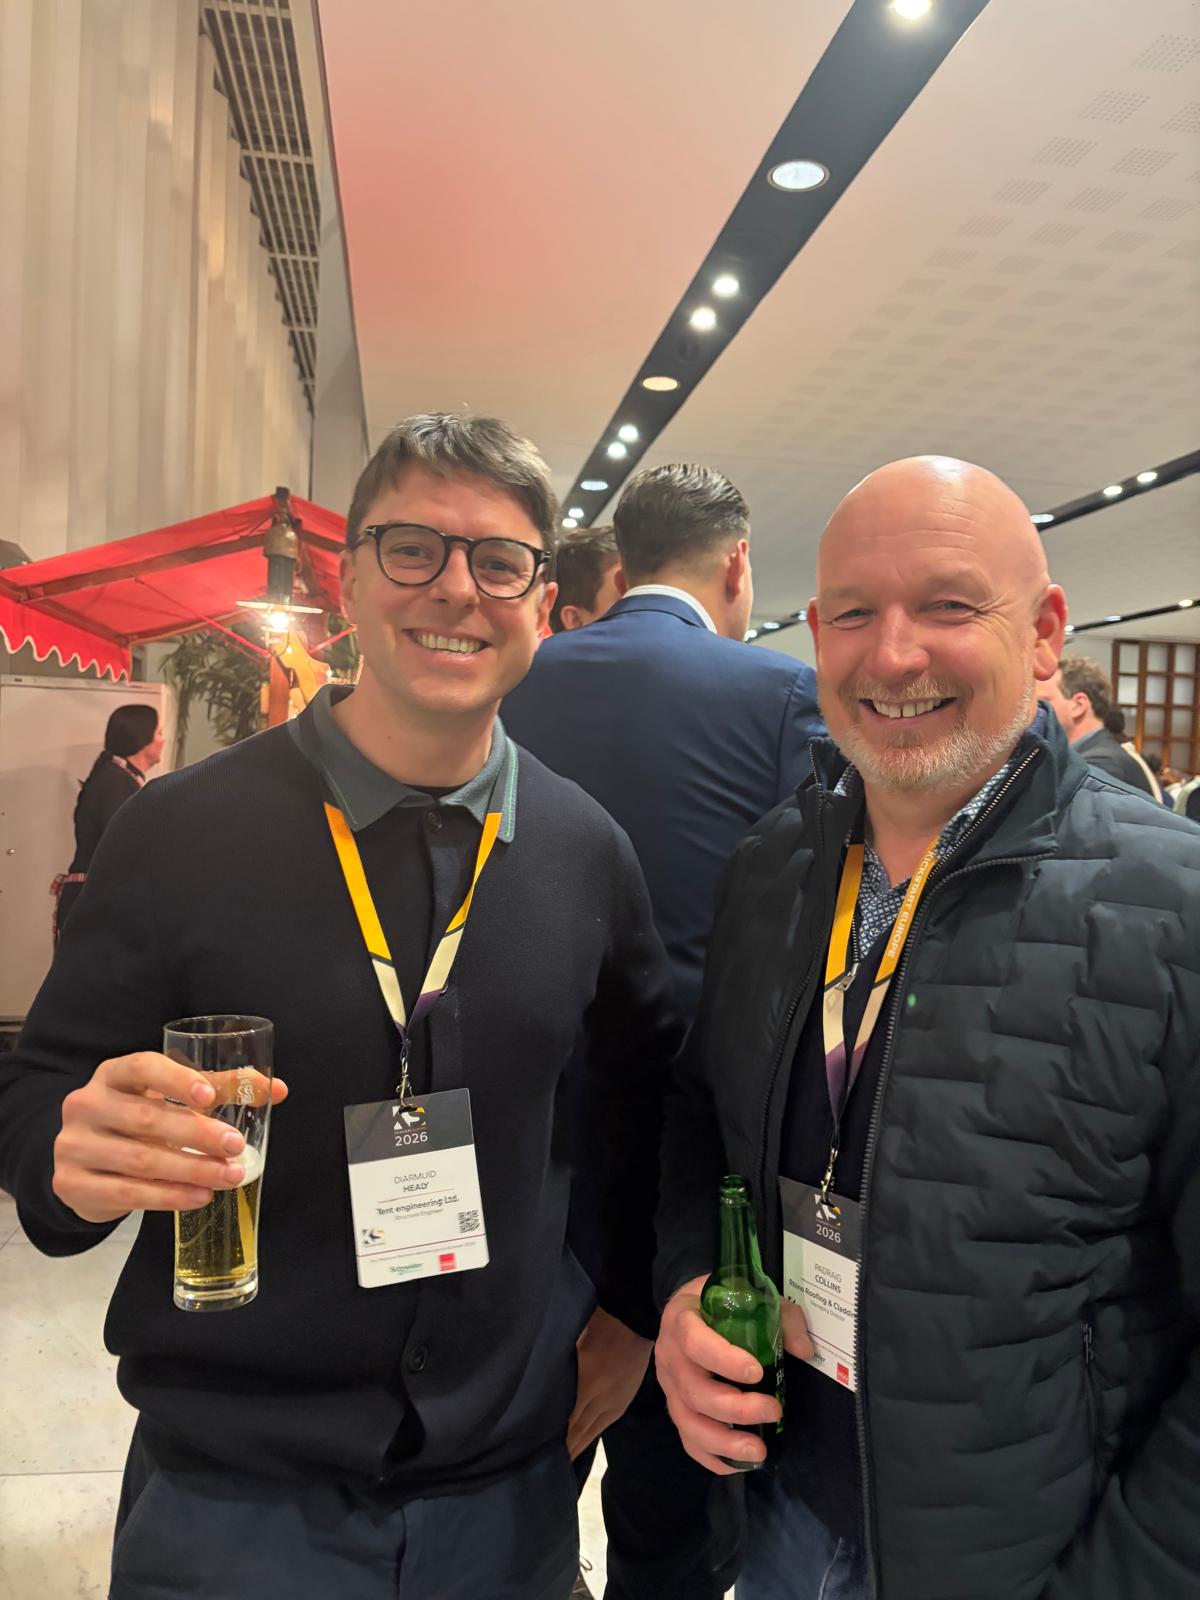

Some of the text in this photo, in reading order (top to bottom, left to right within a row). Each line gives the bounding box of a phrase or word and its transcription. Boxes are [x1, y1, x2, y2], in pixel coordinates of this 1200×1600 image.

[888, 850, 936, 958] KICKSTART EUROPE
[395, 1131, 429, 1147] 2026
[393, 1170, 437, 1184] DIARMUID
[376, 1194, 460, 1216] Tent engineering Ltd.
[815, 1224, 842, 1243] 2026
[814, 1263, 842, 1283] PADRAIG
[814, 1274, 842, 1294] COLLINS
[805, 1287, 827, 1306] Roofing
